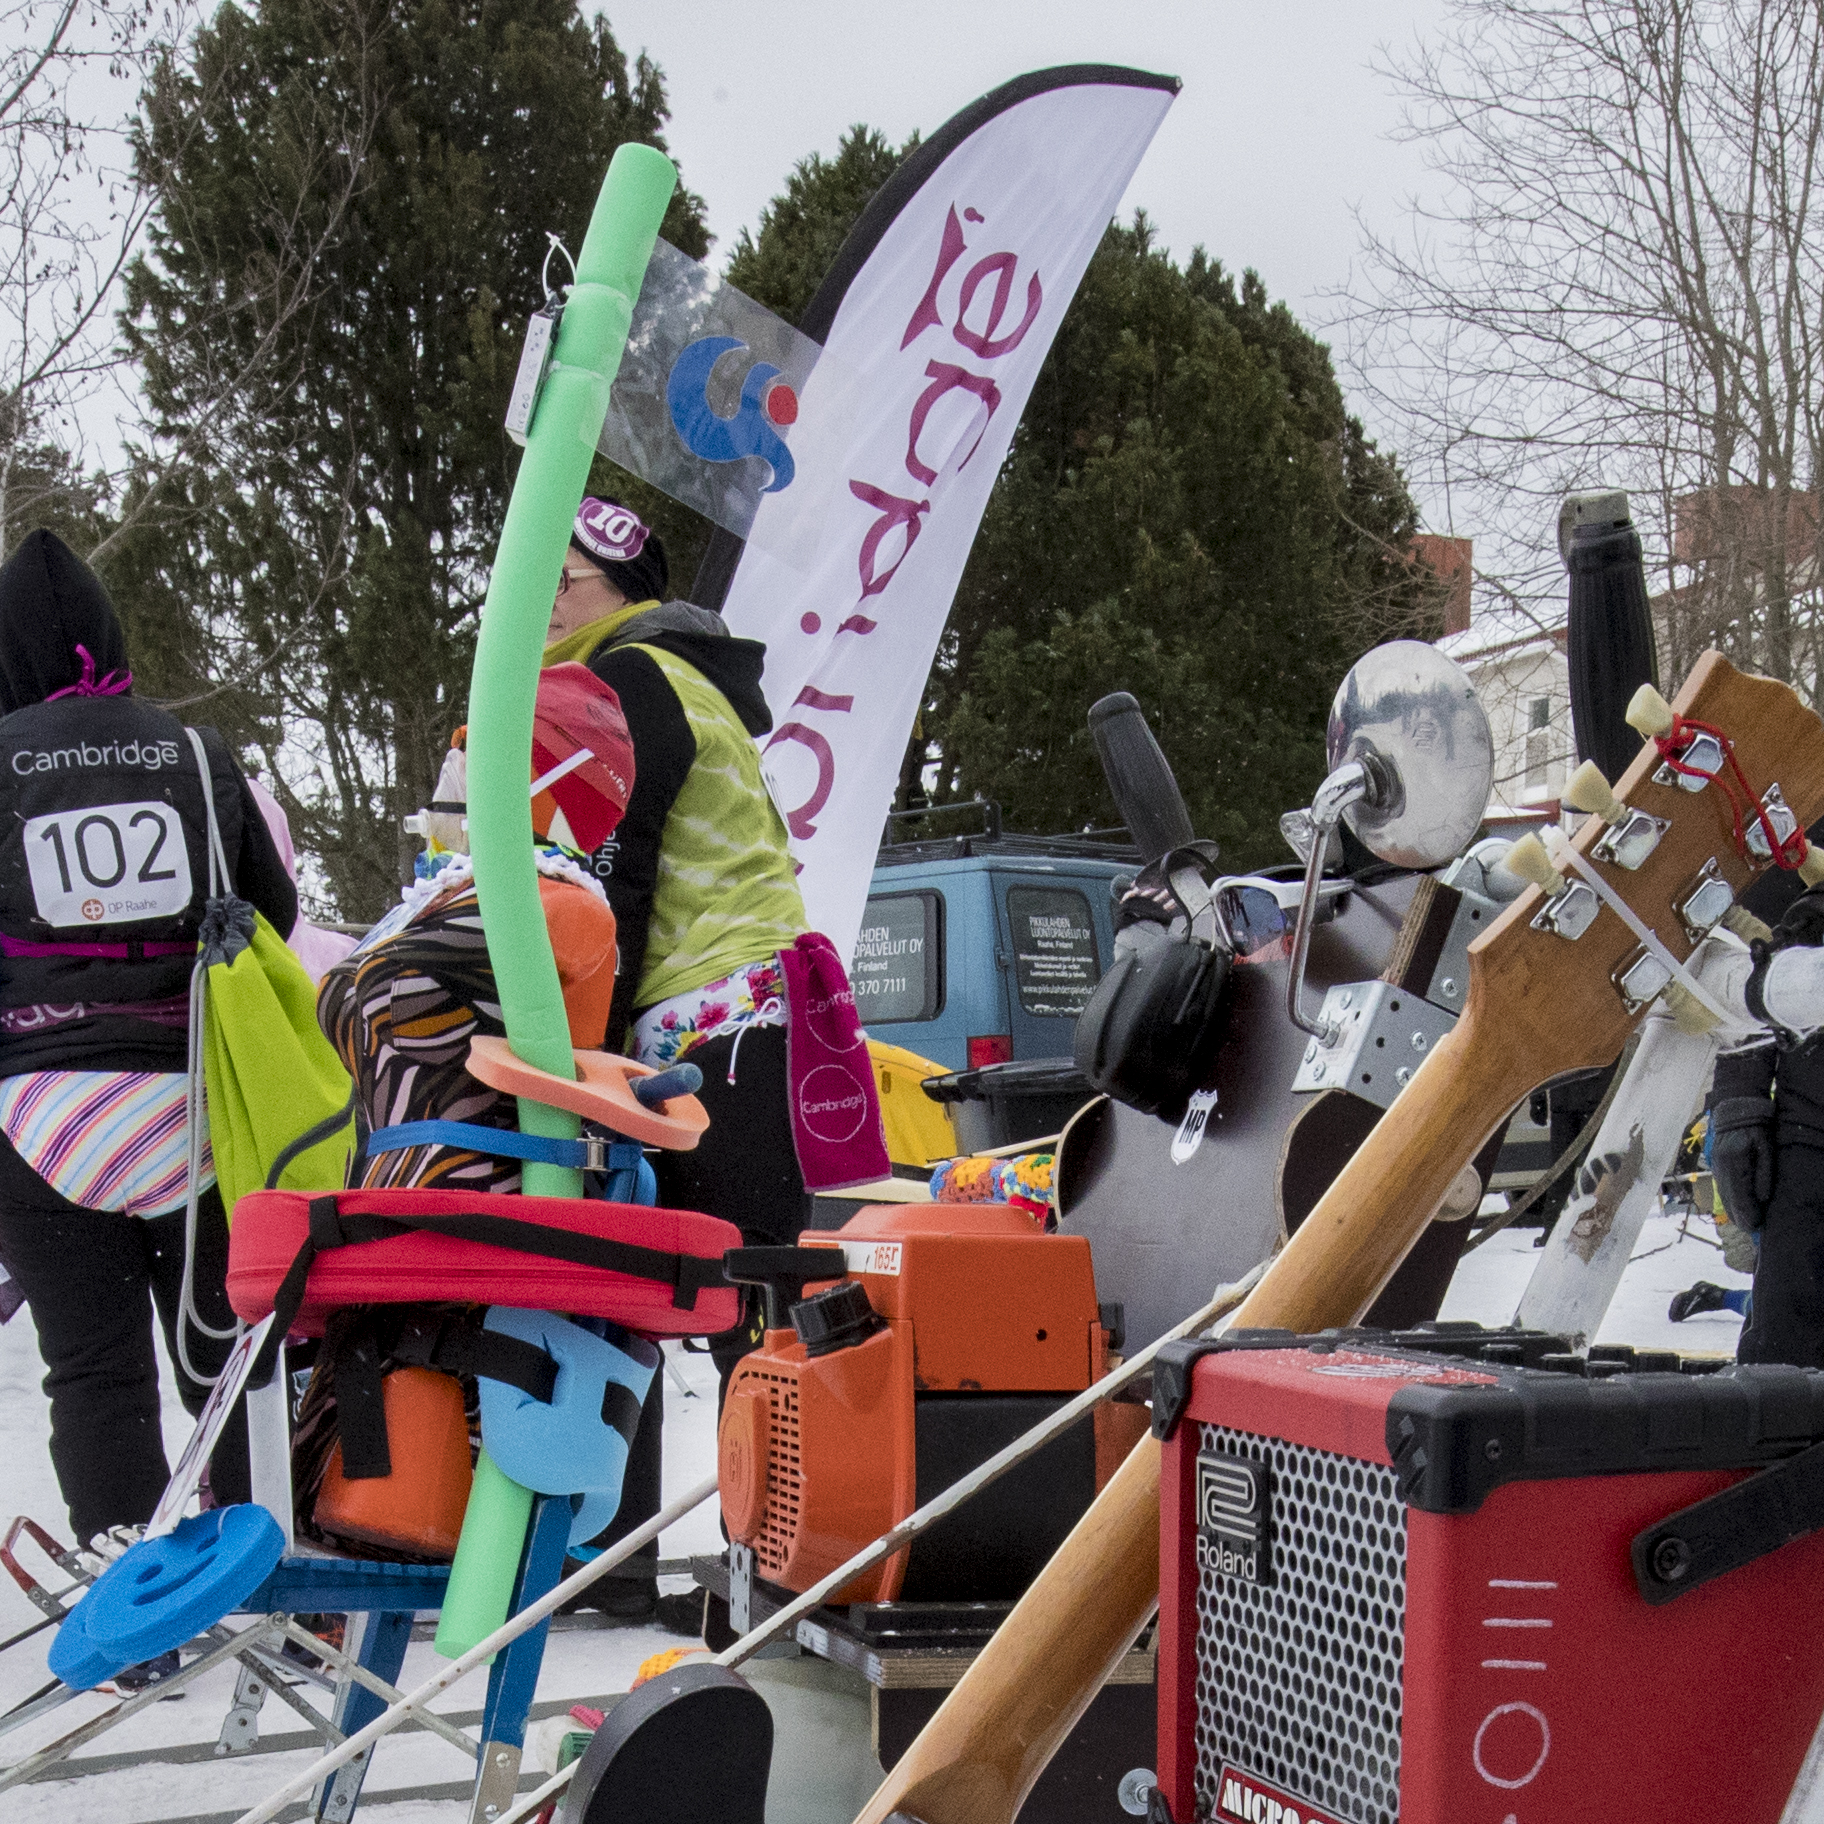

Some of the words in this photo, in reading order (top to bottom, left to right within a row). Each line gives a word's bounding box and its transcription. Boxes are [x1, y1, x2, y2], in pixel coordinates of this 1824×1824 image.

[586, 505, 635, 544] 10
[764, 201, 1042, 876] bridge
[12, 739, 179, 776] Cambridge
[39, 809, 176, 893] 102
[125, 899, 157, 912] Raahe
[909, 937, 924, 954] OY
[857, 960, 888, 972] Finland
[858, 979, 880, 996] 370
[883, 977, 906, 994] 7111
[802, 1094, 862, 1114] Cambridge
[1178, 1108, 1206, 1144] MP
[1195, 1533, 1257, 1582] Roland
